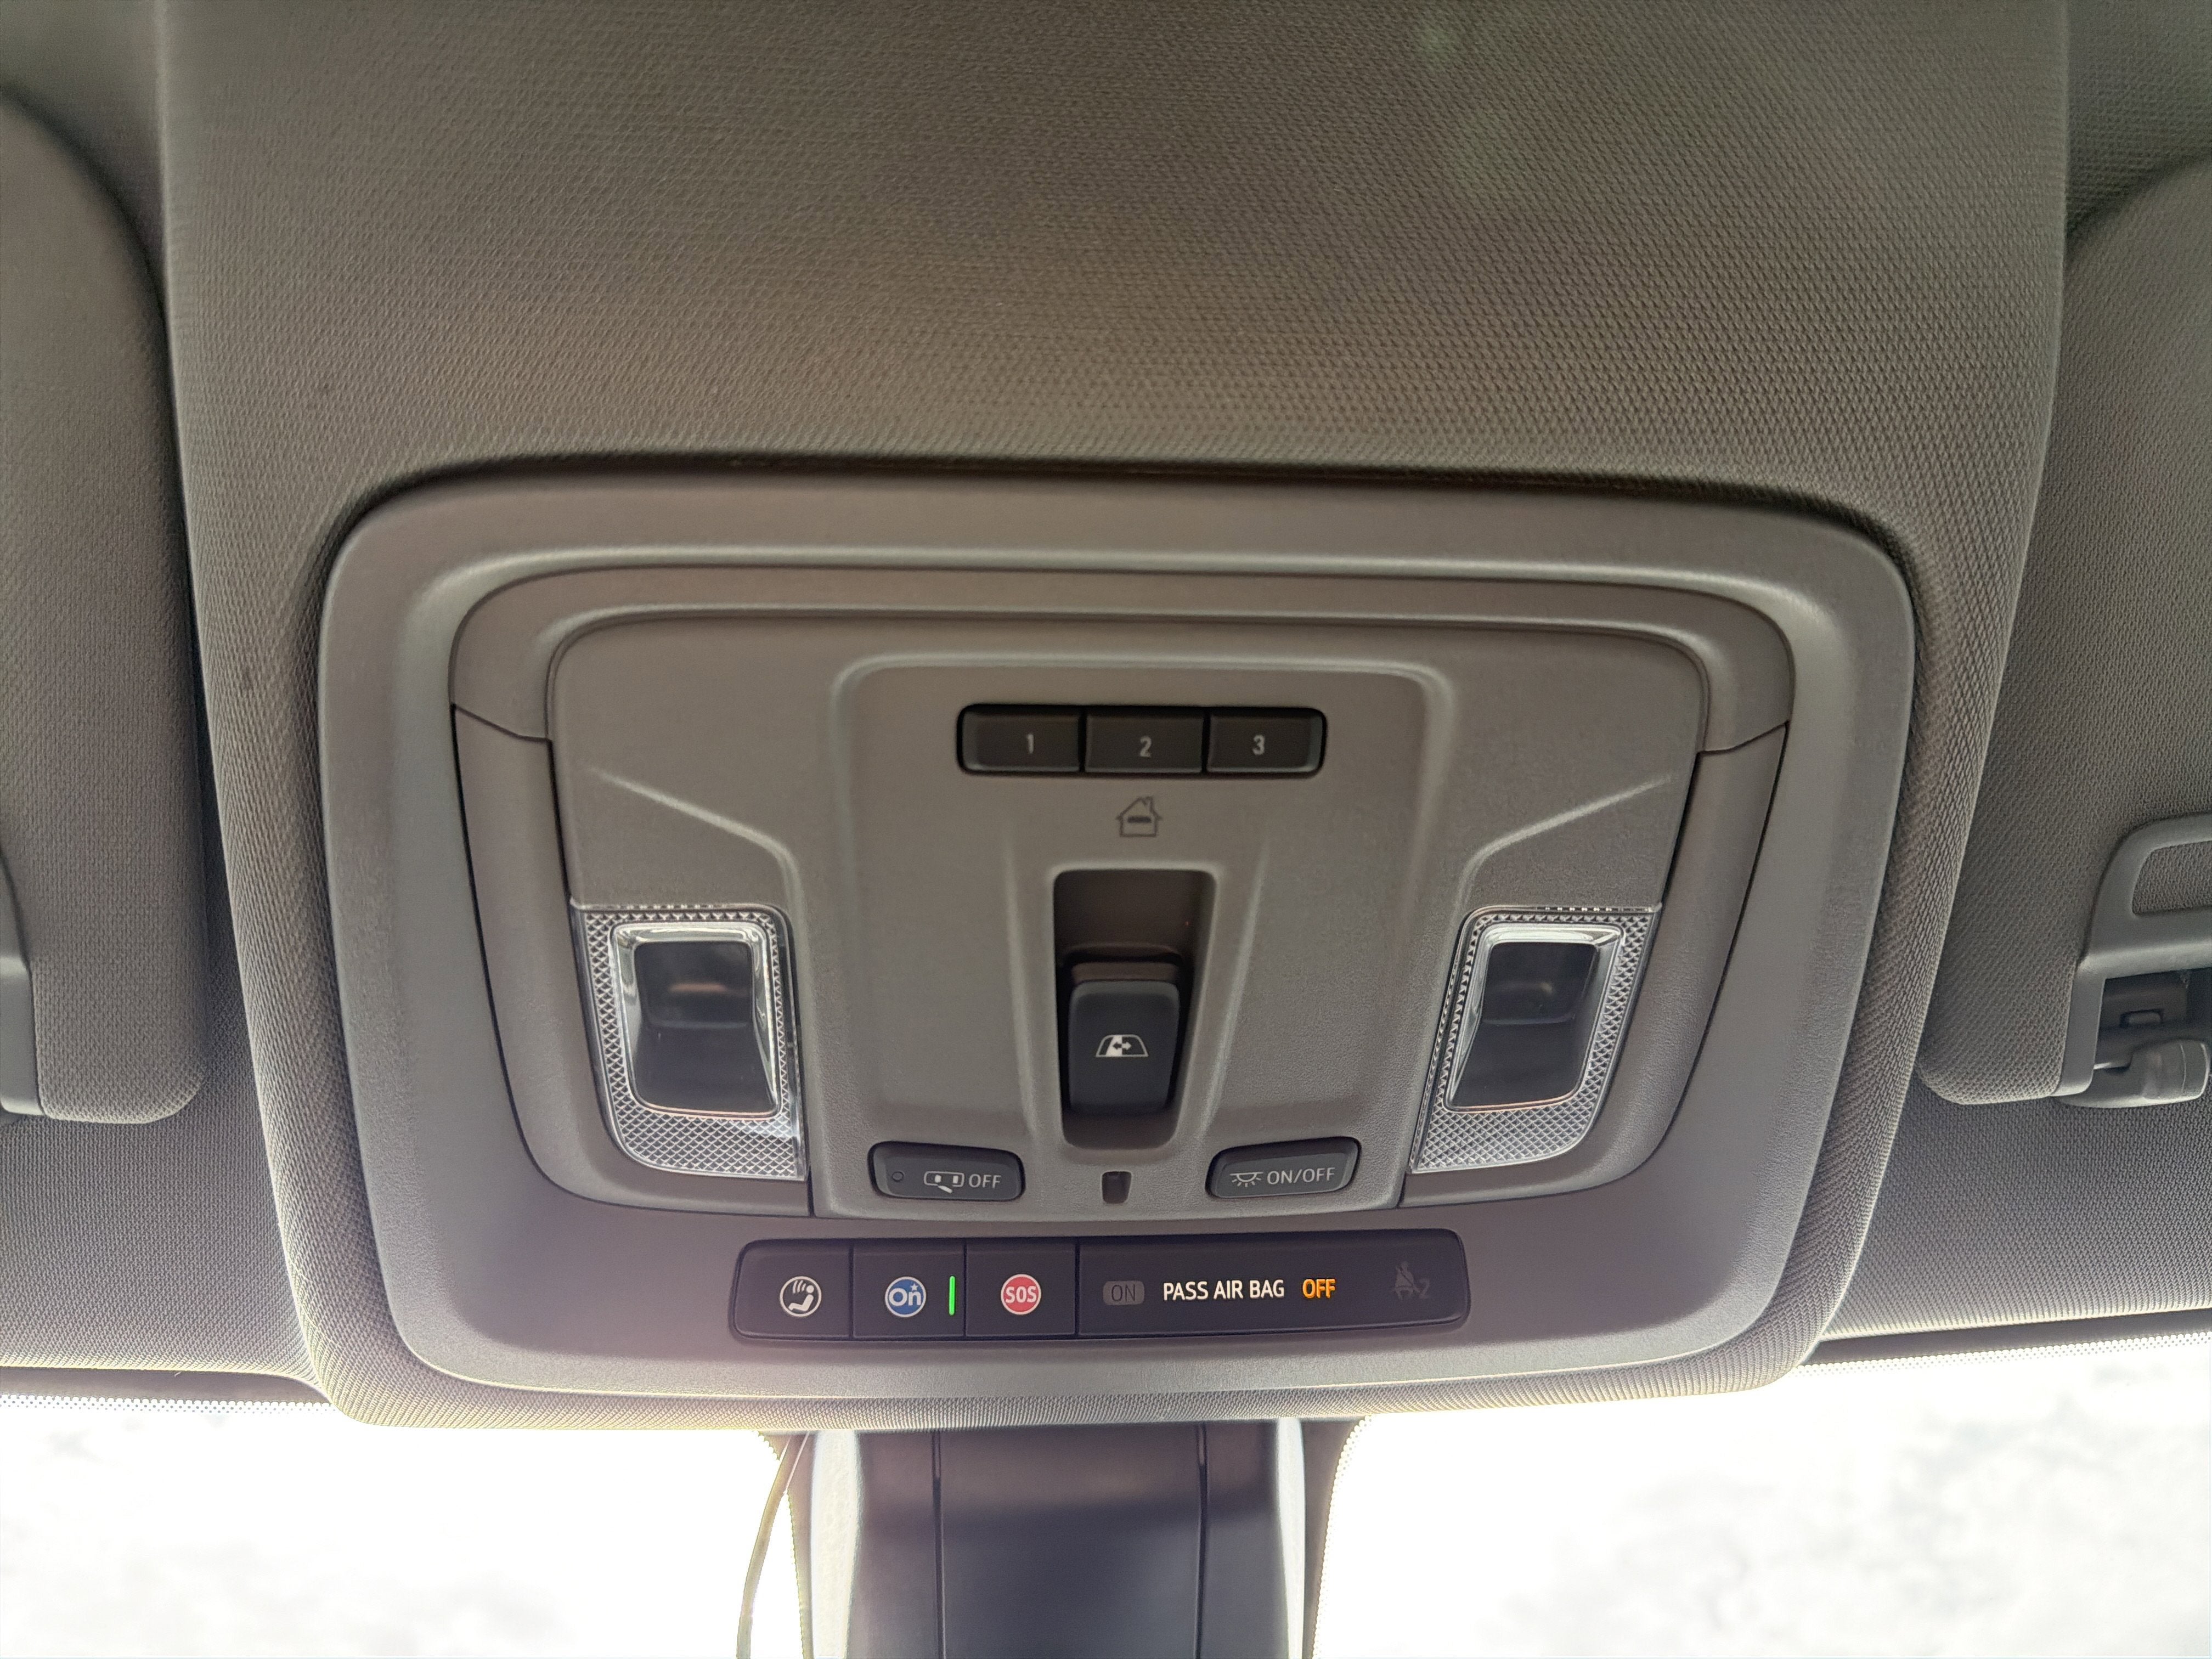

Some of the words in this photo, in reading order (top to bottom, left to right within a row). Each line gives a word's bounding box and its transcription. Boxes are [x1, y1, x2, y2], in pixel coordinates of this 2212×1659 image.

[1026, 734, 1035, 753] 1
[1140, 737, 1152, 757] 2
[1253, 735, 1265, 755] 3
[968, 1173, 1002, 1189] OFF
[1267, 1167, 1336, 1185] ON/OFF
[1006, 1286, 1036, 1302] SOS
[1111, 1284, 1136, 1301] ON
[1164, 1282, 1208, 1300] PASS
[1214, 1280, 1243, 1299] AIR
[1250, 1280, 1284, 1298] BAG
[1302, 1278, 1335, 1298] OFF
